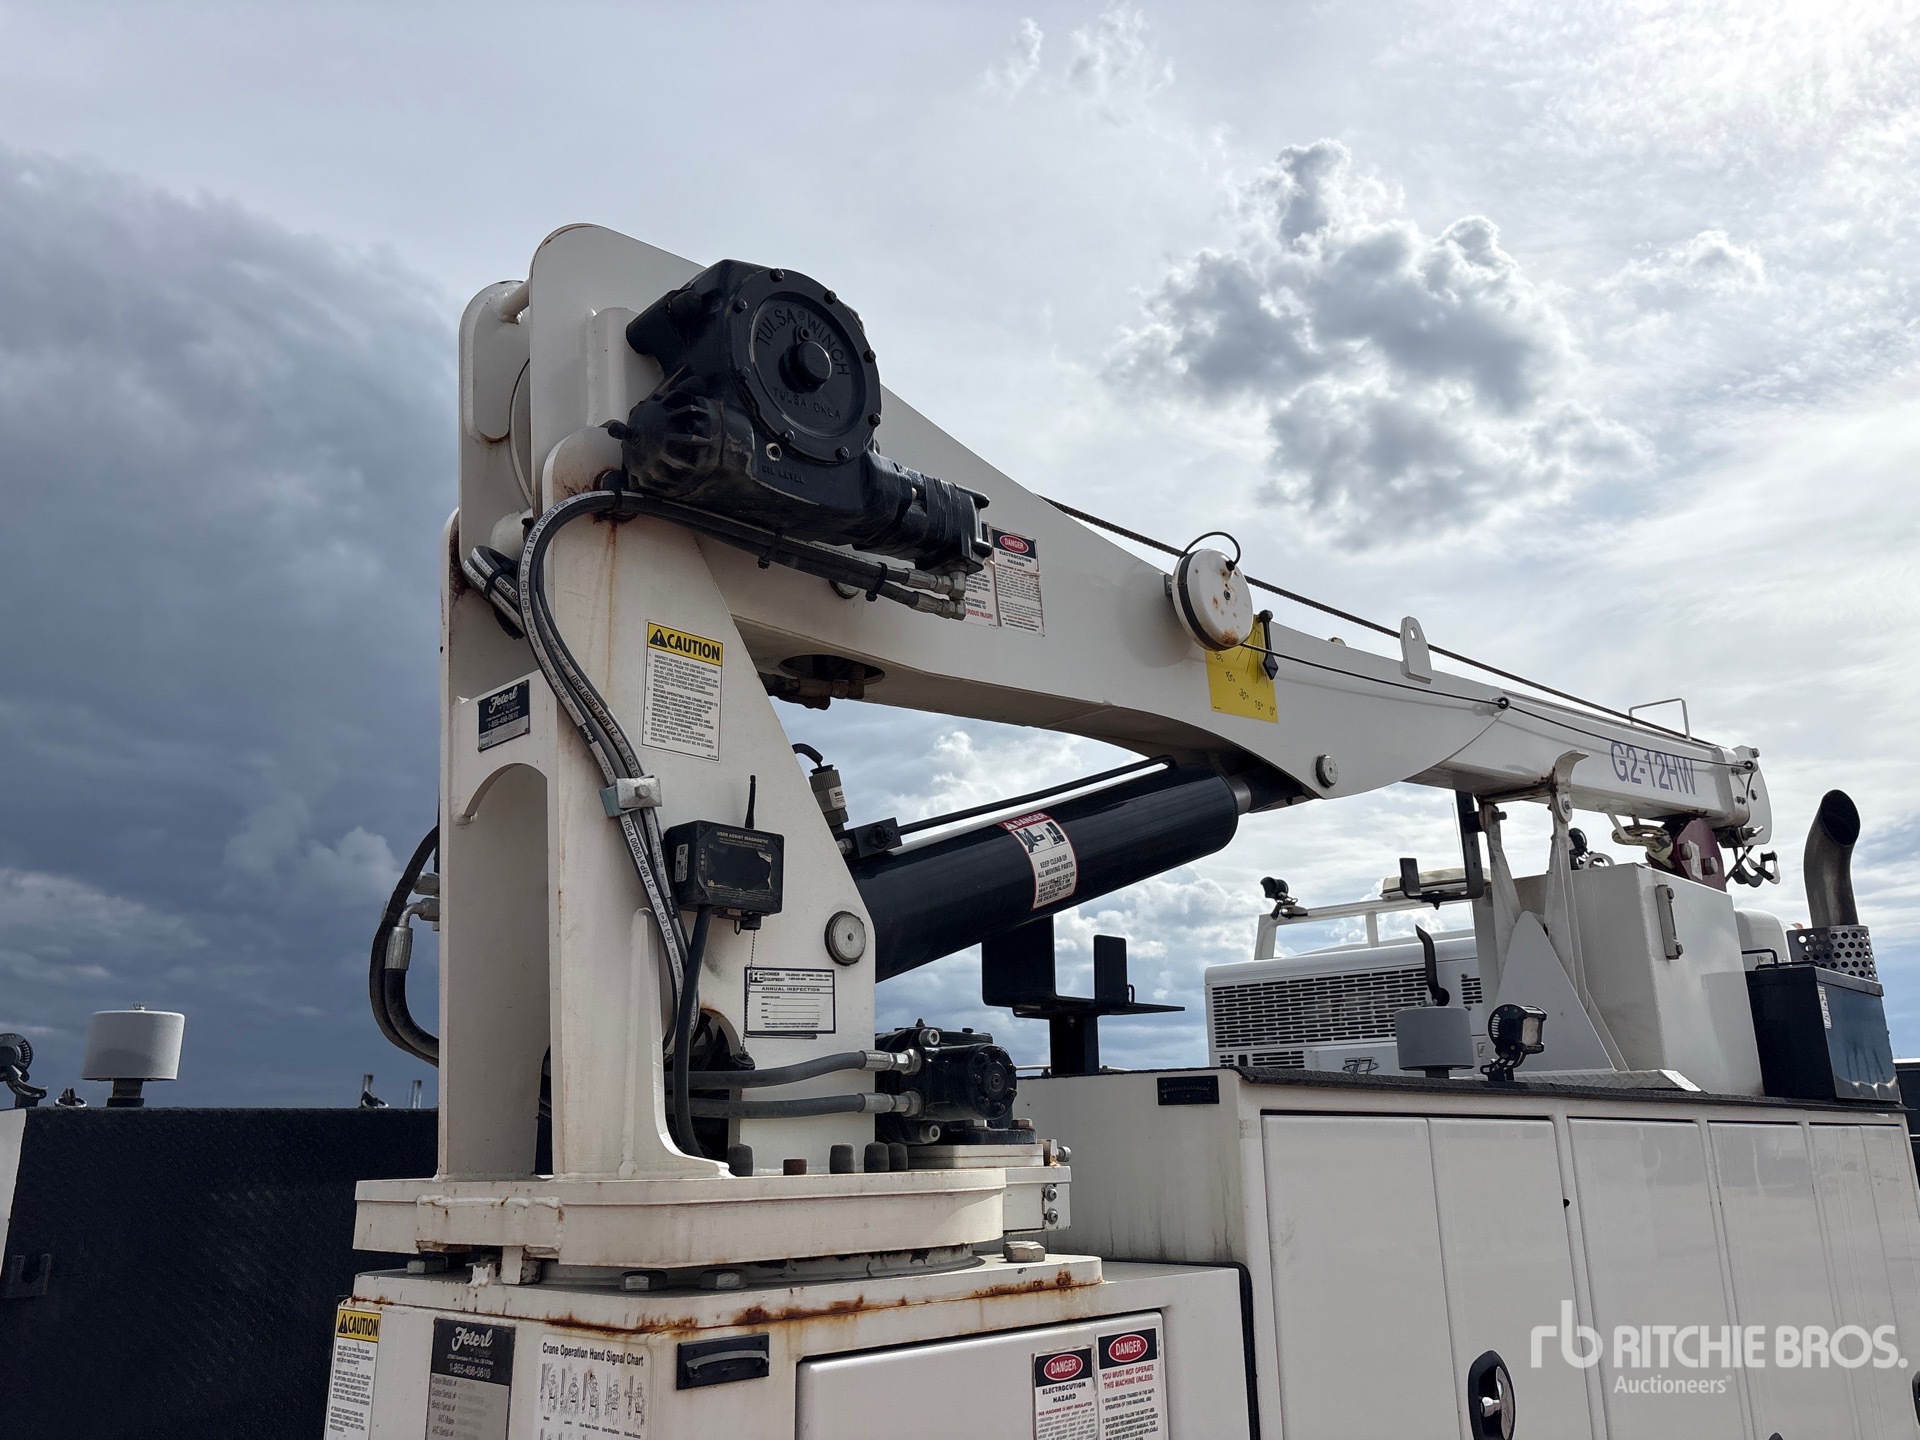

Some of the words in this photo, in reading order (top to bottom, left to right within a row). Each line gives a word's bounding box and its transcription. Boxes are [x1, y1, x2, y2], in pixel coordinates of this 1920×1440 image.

[755, 309, 796, 346] TULSA
[807, 319, 850, 376] WINCH
[528, 526, 542, 544] MPa
[525, 545, 534, 555] 21
[1005, 538, 1024, 550] DANGER
[999, 551, 1032, 563] ELECTROCUTION
[1007, 559, 1025, 567] HAZARD
[667, 634, 720, 661] CAUTION
[569, 673, 586, 692] PSI)
[1226, 671, 1235, 682] 45°
[582, 690, 601, 711] (3000
[1239, 689, 1249, 700] 30°
[1255, 700, 1263, 710] 15°
[597, 710, 612, 727] MPa
[609, 726, 618, 736] 21
[1610, 742, 1696, 795] G2-12HW
[623, 819, 636, 837] PSI)
[630, 836, 644, 859] (3000
[638, 859, 651, 878] MPa
[1040, 860, 1049, 869] KEEP
[1050, 855, 1062, 866] CLEAR
[1045, 865, 1060, 876] MOVING
[1061, 860, 1073, 871] PARTS
[645, 879, 655, 890] 21
[348, 1316, 378, 1336] CAUTION
[543, 1342, 559, 1355] Crane
[560, 1344, 588, 1362] Operation
[589, 1349, 605, 1362] Hand
[606, 1350, 625, 1367] Signal
[627, 1353, 644, 1367] Chart
[1116, 1340, 1142, 1356] DANGER
[1051, 1359, 1076, 1375] DANGER
[1102, 1372, 1111, 1381] YOU
[1113, 1370, 1124, 1378] MUST
[1126, 1368, 1134, 1376] NOT
[1135, 1364, 1154, 1374] OPERATE
[1042, 1381, 1086, 1395] ELECTROCUTION
[1104, 1381, 1114, 1390] THIS
[1115, 1377, 1135, 1387] MACHINE
[1053, 1393, 1076, 1403] HAZARD
